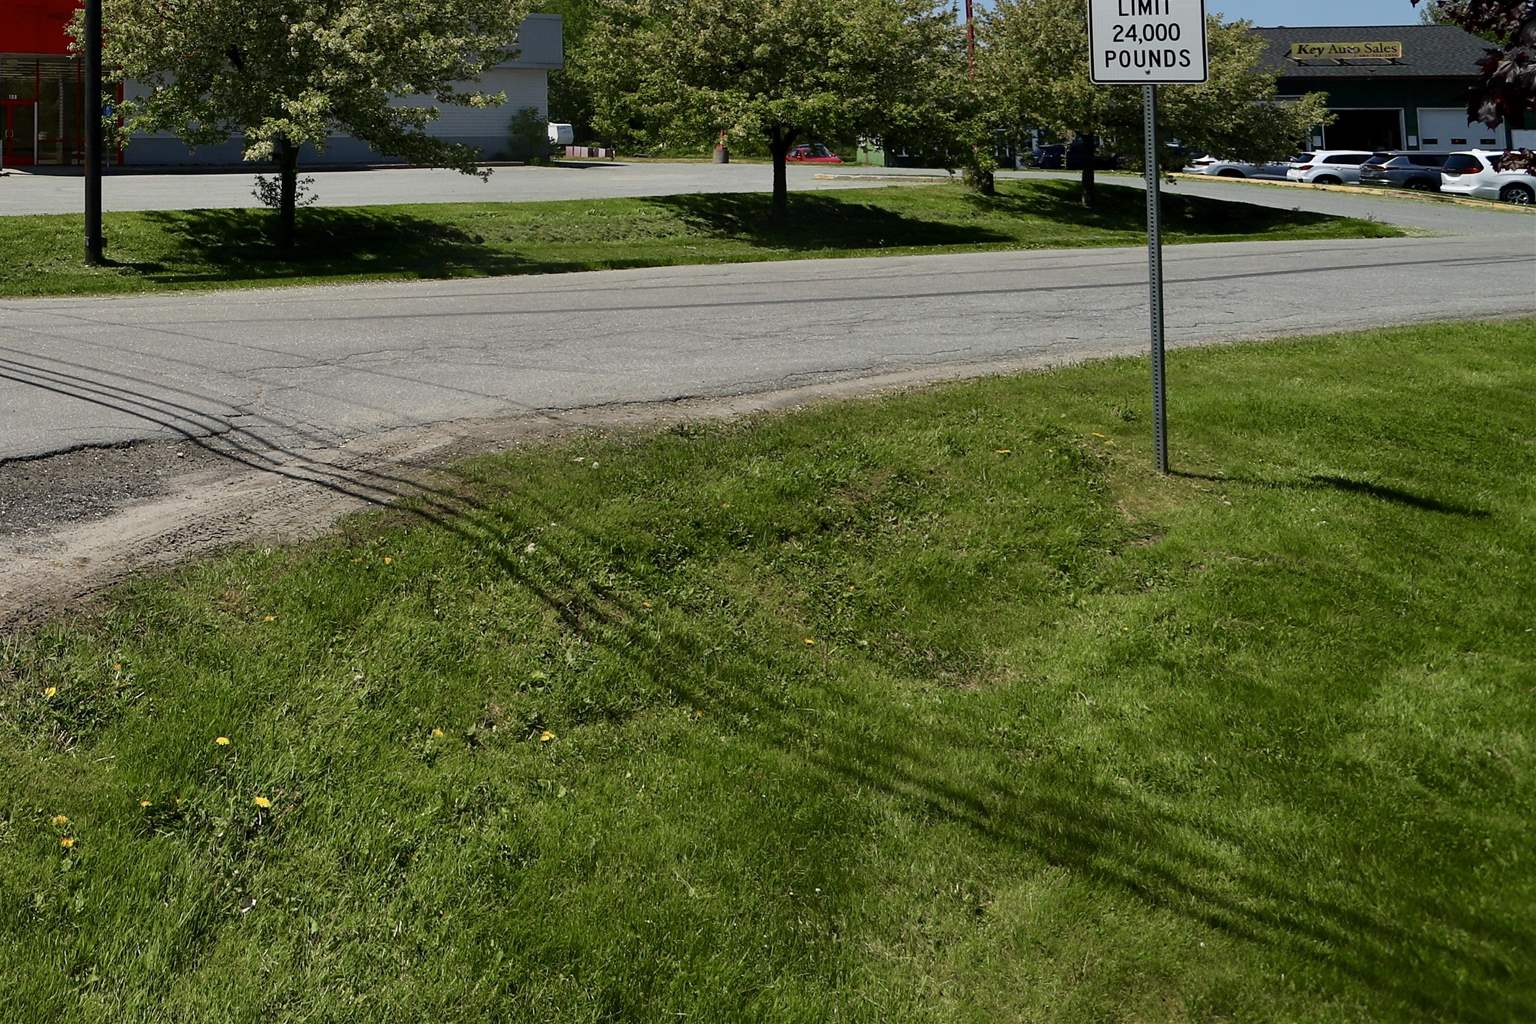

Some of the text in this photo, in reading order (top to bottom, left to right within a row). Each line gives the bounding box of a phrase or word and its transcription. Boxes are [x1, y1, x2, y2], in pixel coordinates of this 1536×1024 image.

[1112, 23, 1181, 45] 24,000
[1105, 49, 1191, 68] POUNDS
[1297, 43, 1398, 57] Key Auto Sales
